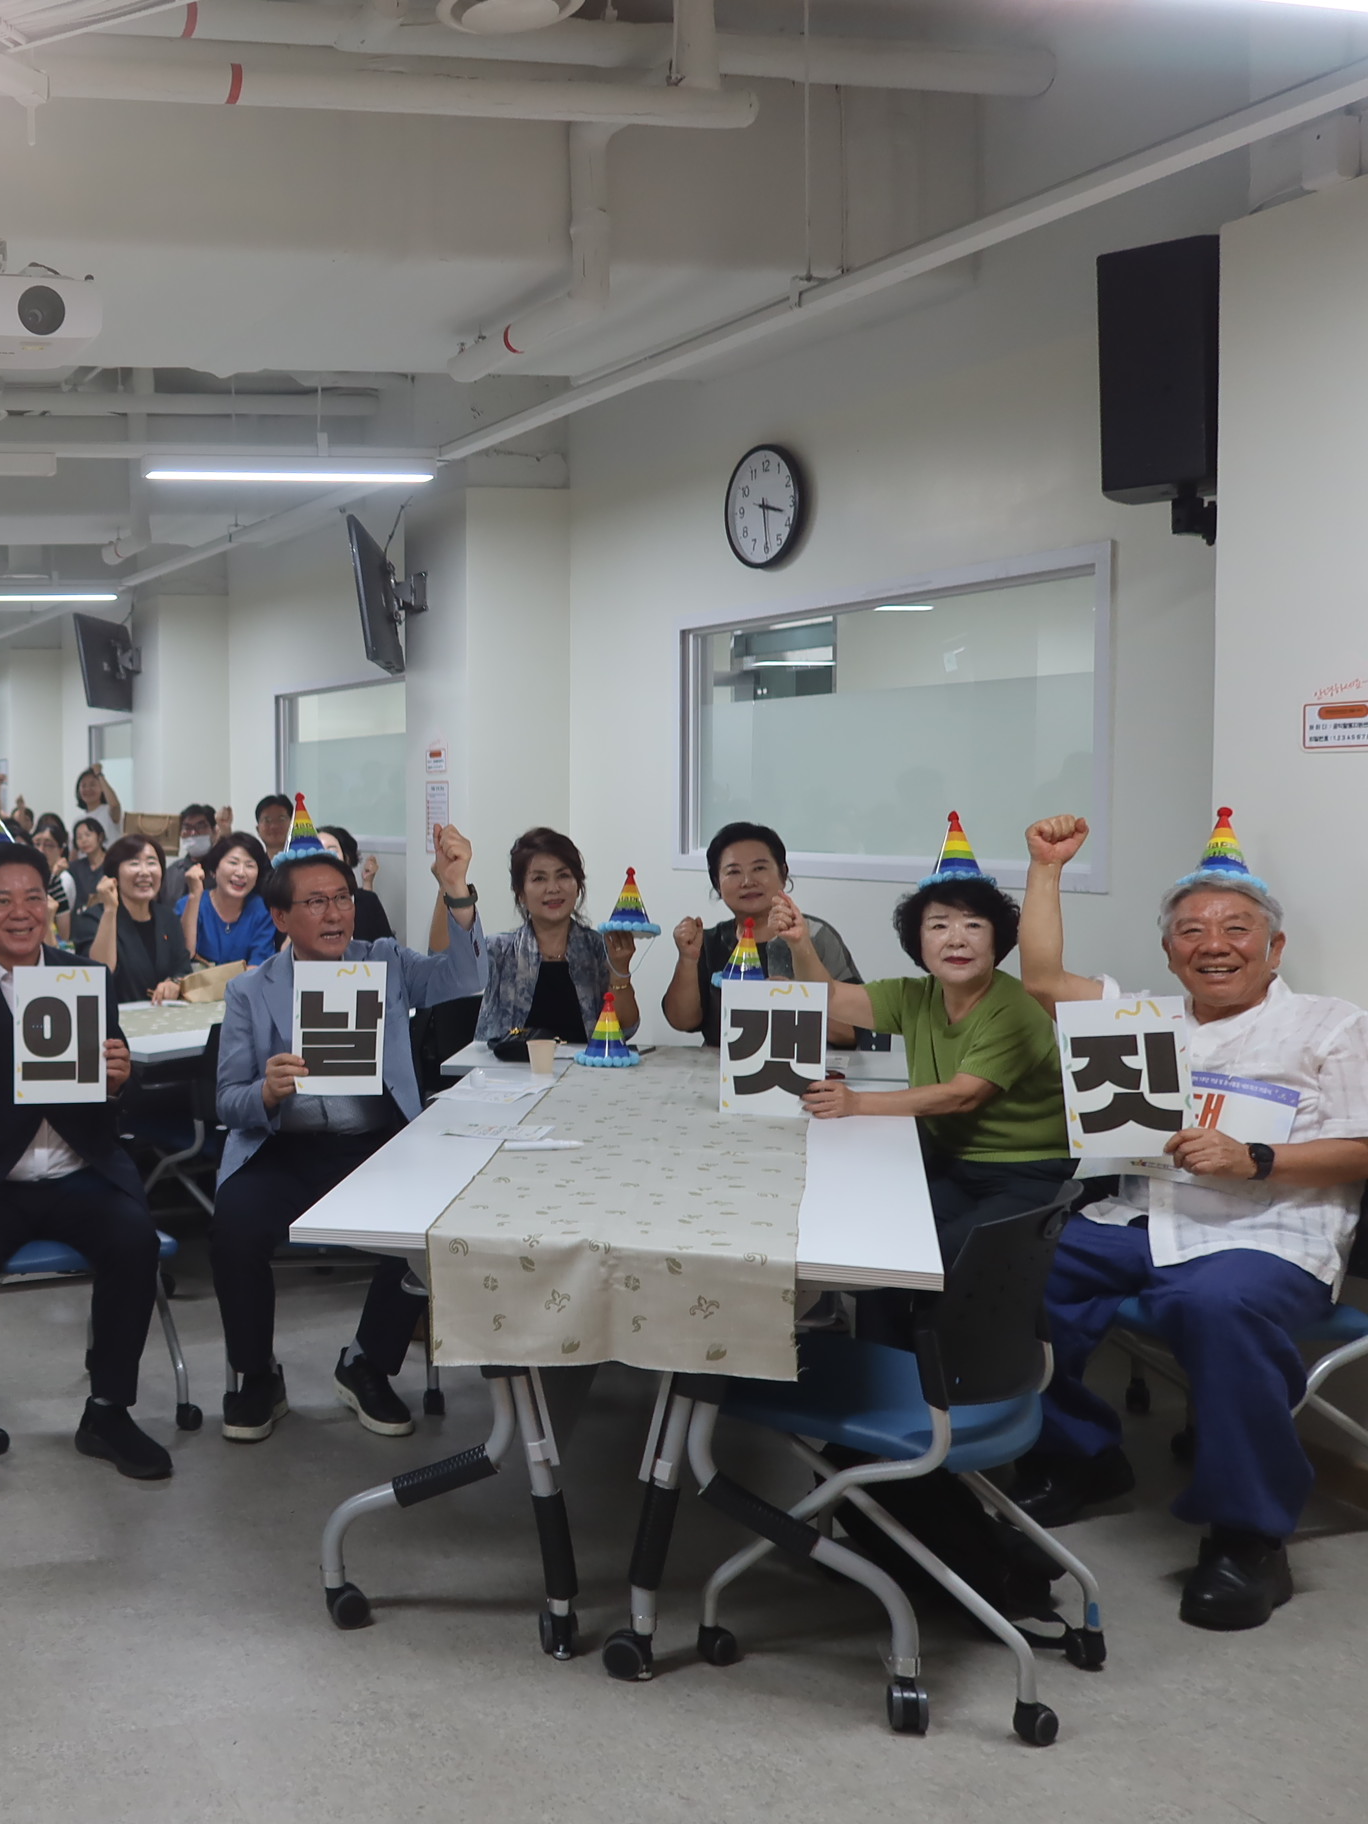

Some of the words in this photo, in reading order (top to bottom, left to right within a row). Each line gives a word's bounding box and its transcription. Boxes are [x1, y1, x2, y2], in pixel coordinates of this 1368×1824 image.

[761, 459, 771, 473] 12
[750, 468, 758, 481] 11
[784, 475, 791, 488] 2
[741, 485, 750, 498] 10
[789, 495, 795, 508] 3
[739, 506, 745, 519] 9
[784, 516, 792, 529] 4
[742, 526, 749, 539] 8
[751, 538, 757, 552] 7
[776, 533, 783, 546] 5
[763, 541, 770, 555] 6
[21, 995, 100, 1084] 의
[300, 990, 384, 1077] 날
[727, 1008, 823, 1097] 갯
[1070, 1031, 1184, 1134] 짓
